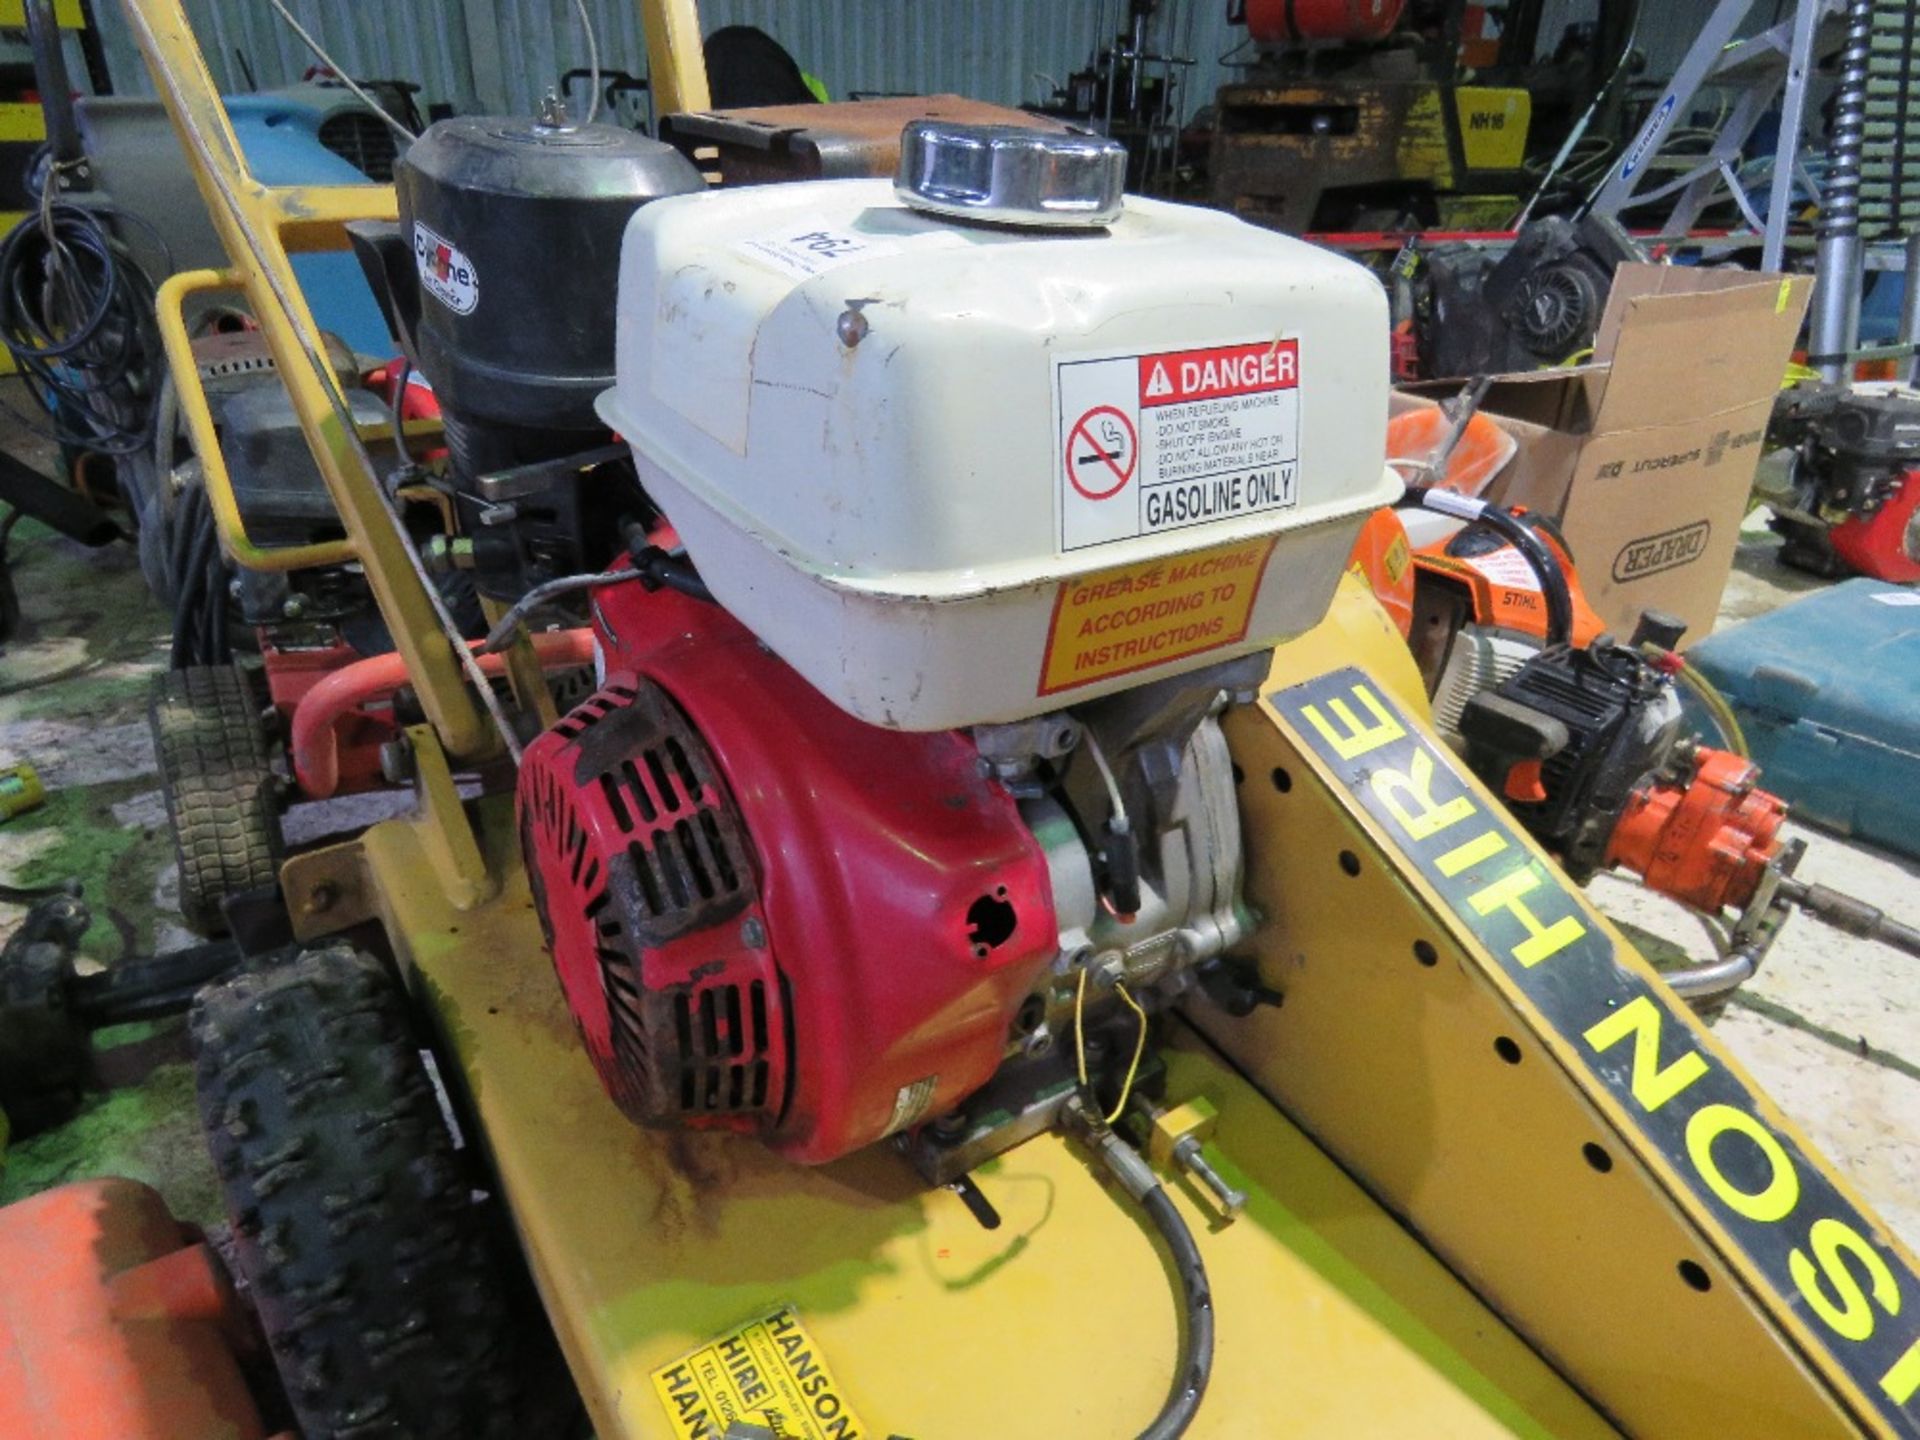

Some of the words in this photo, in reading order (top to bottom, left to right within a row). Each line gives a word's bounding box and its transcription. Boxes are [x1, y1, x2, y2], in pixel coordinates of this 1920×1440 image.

[1182, 353, 1295, 393] DANGER
[1156, 408, 1185, 421] WHEN
[1187, 401, 1239, 417] REFUELING
[1241, 395, 1280, 410] MACHINE
[1176, 420, 1196, 433] NOT
[1199, 416, 1230, 431] SMOKE
[1176, 448, 1196, 462] NOT
[1198, 443, 1230, 458] ALLOW
[1230, 440, 1249, 453] ANY
[1251, 437, 1269, 448] HOT
[1271, 434, 1284, 446] OR
[1187, 433, 1205, 446] OFF
[1207, 427, 1242, 442] ENGINE
[1160, 462, 1202, 479] BURNING
[1203, 452, 1253, 471] MATERIALS
[1255, 448, 1280, 462] NEAR
[1147, 477, 1241, 527] GASOLINE
[1247, 468, 1292, 507] ONLY
[1623, 529, 1704, 574] DRAPER
[1072, 567, 1164, 607] GREASE
[1168, 550, 1258, 583] MACHINE
[1502, 591, 1537, 610] STIHL
[1079, 591, 1205, 638] ACCORDING
[1211, 583, 1236, 605] TO
[1074, 616, 1225, 671] INSTRUCTIONS
[1300, 684, 1587, 969] HIRE
[1582, 995, 1920, 1406] SON
[718, 1335, 769, 1405] HIRE
[766, 1310, 858, 1440] HANSON
[714, 1390, 739, 1423] 0126
